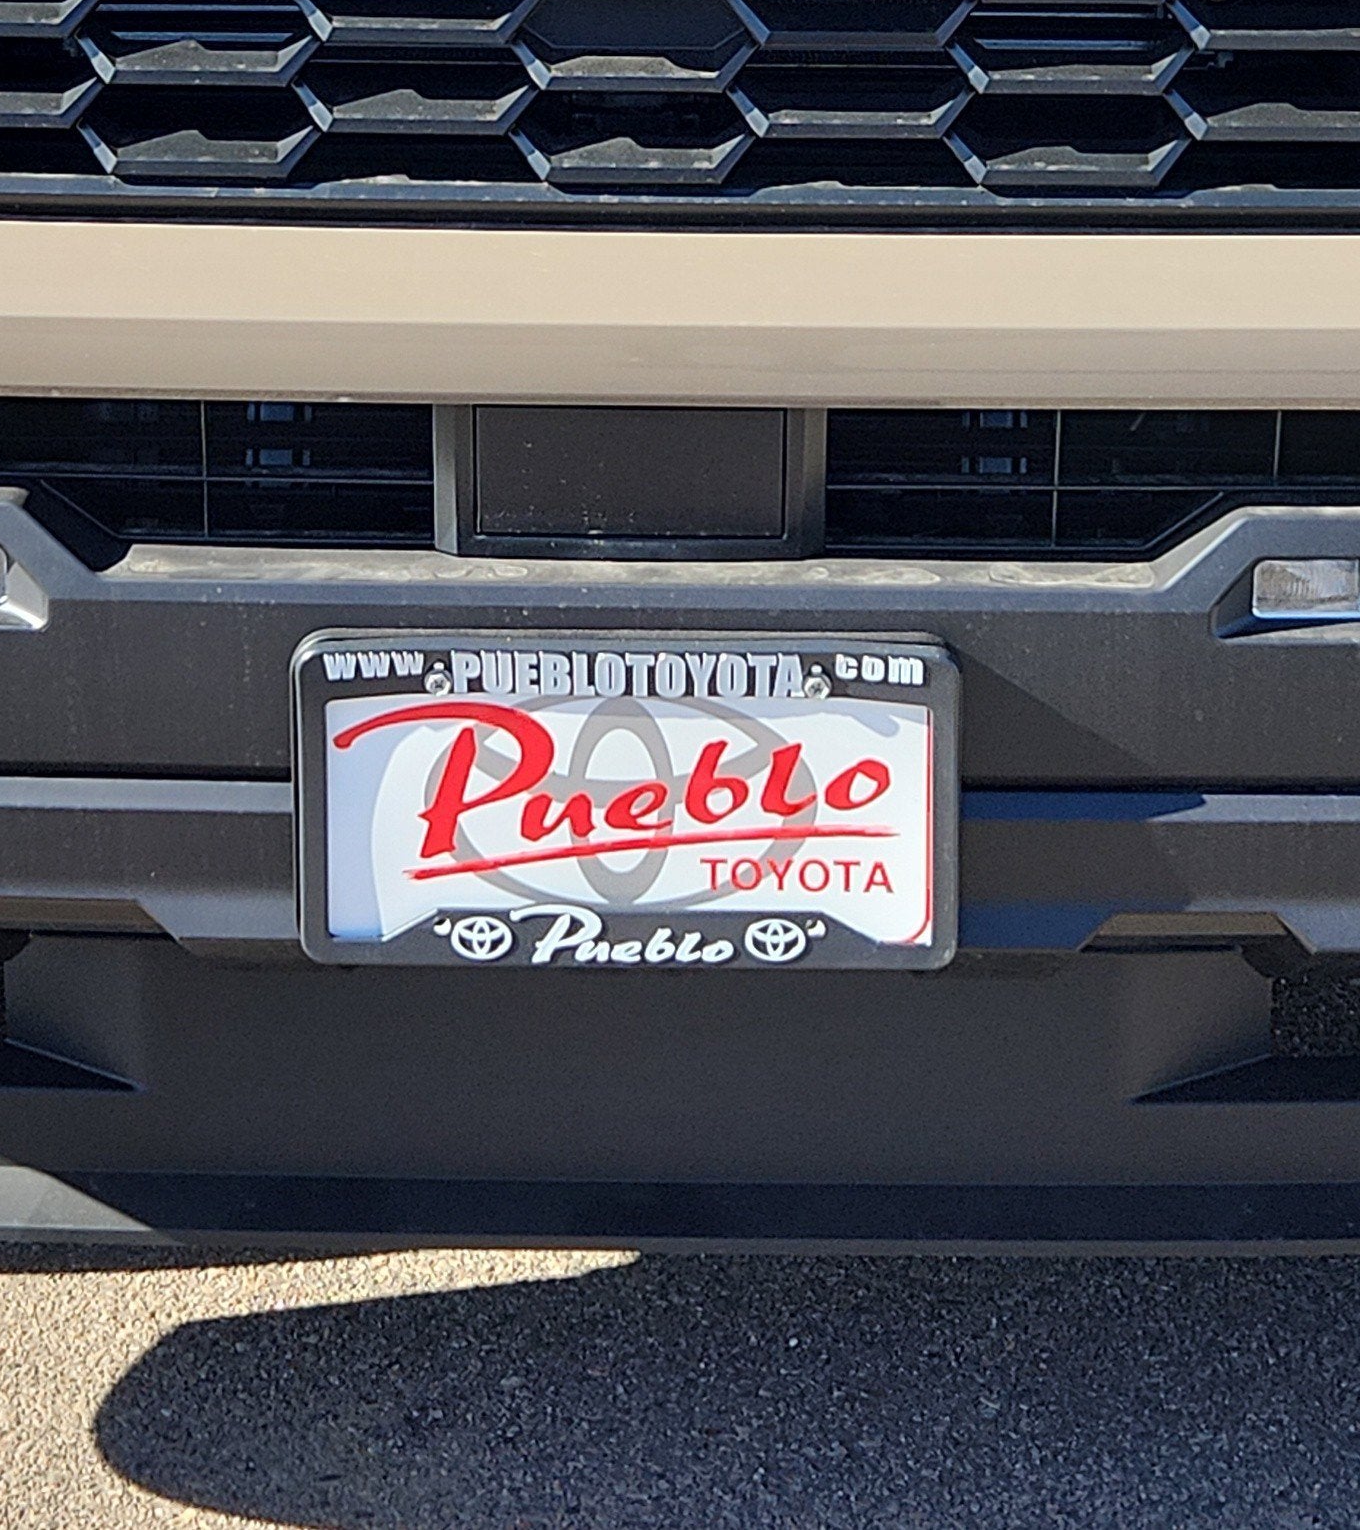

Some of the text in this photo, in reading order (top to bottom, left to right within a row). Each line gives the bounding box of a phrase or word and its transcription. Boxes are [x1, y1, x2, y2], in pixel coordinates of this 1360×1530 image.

[332, 701, 891, 858] Pueblo
[700, 858, 895, 894] TOYOTA
[509, 904, 736, 964] Pueblo
